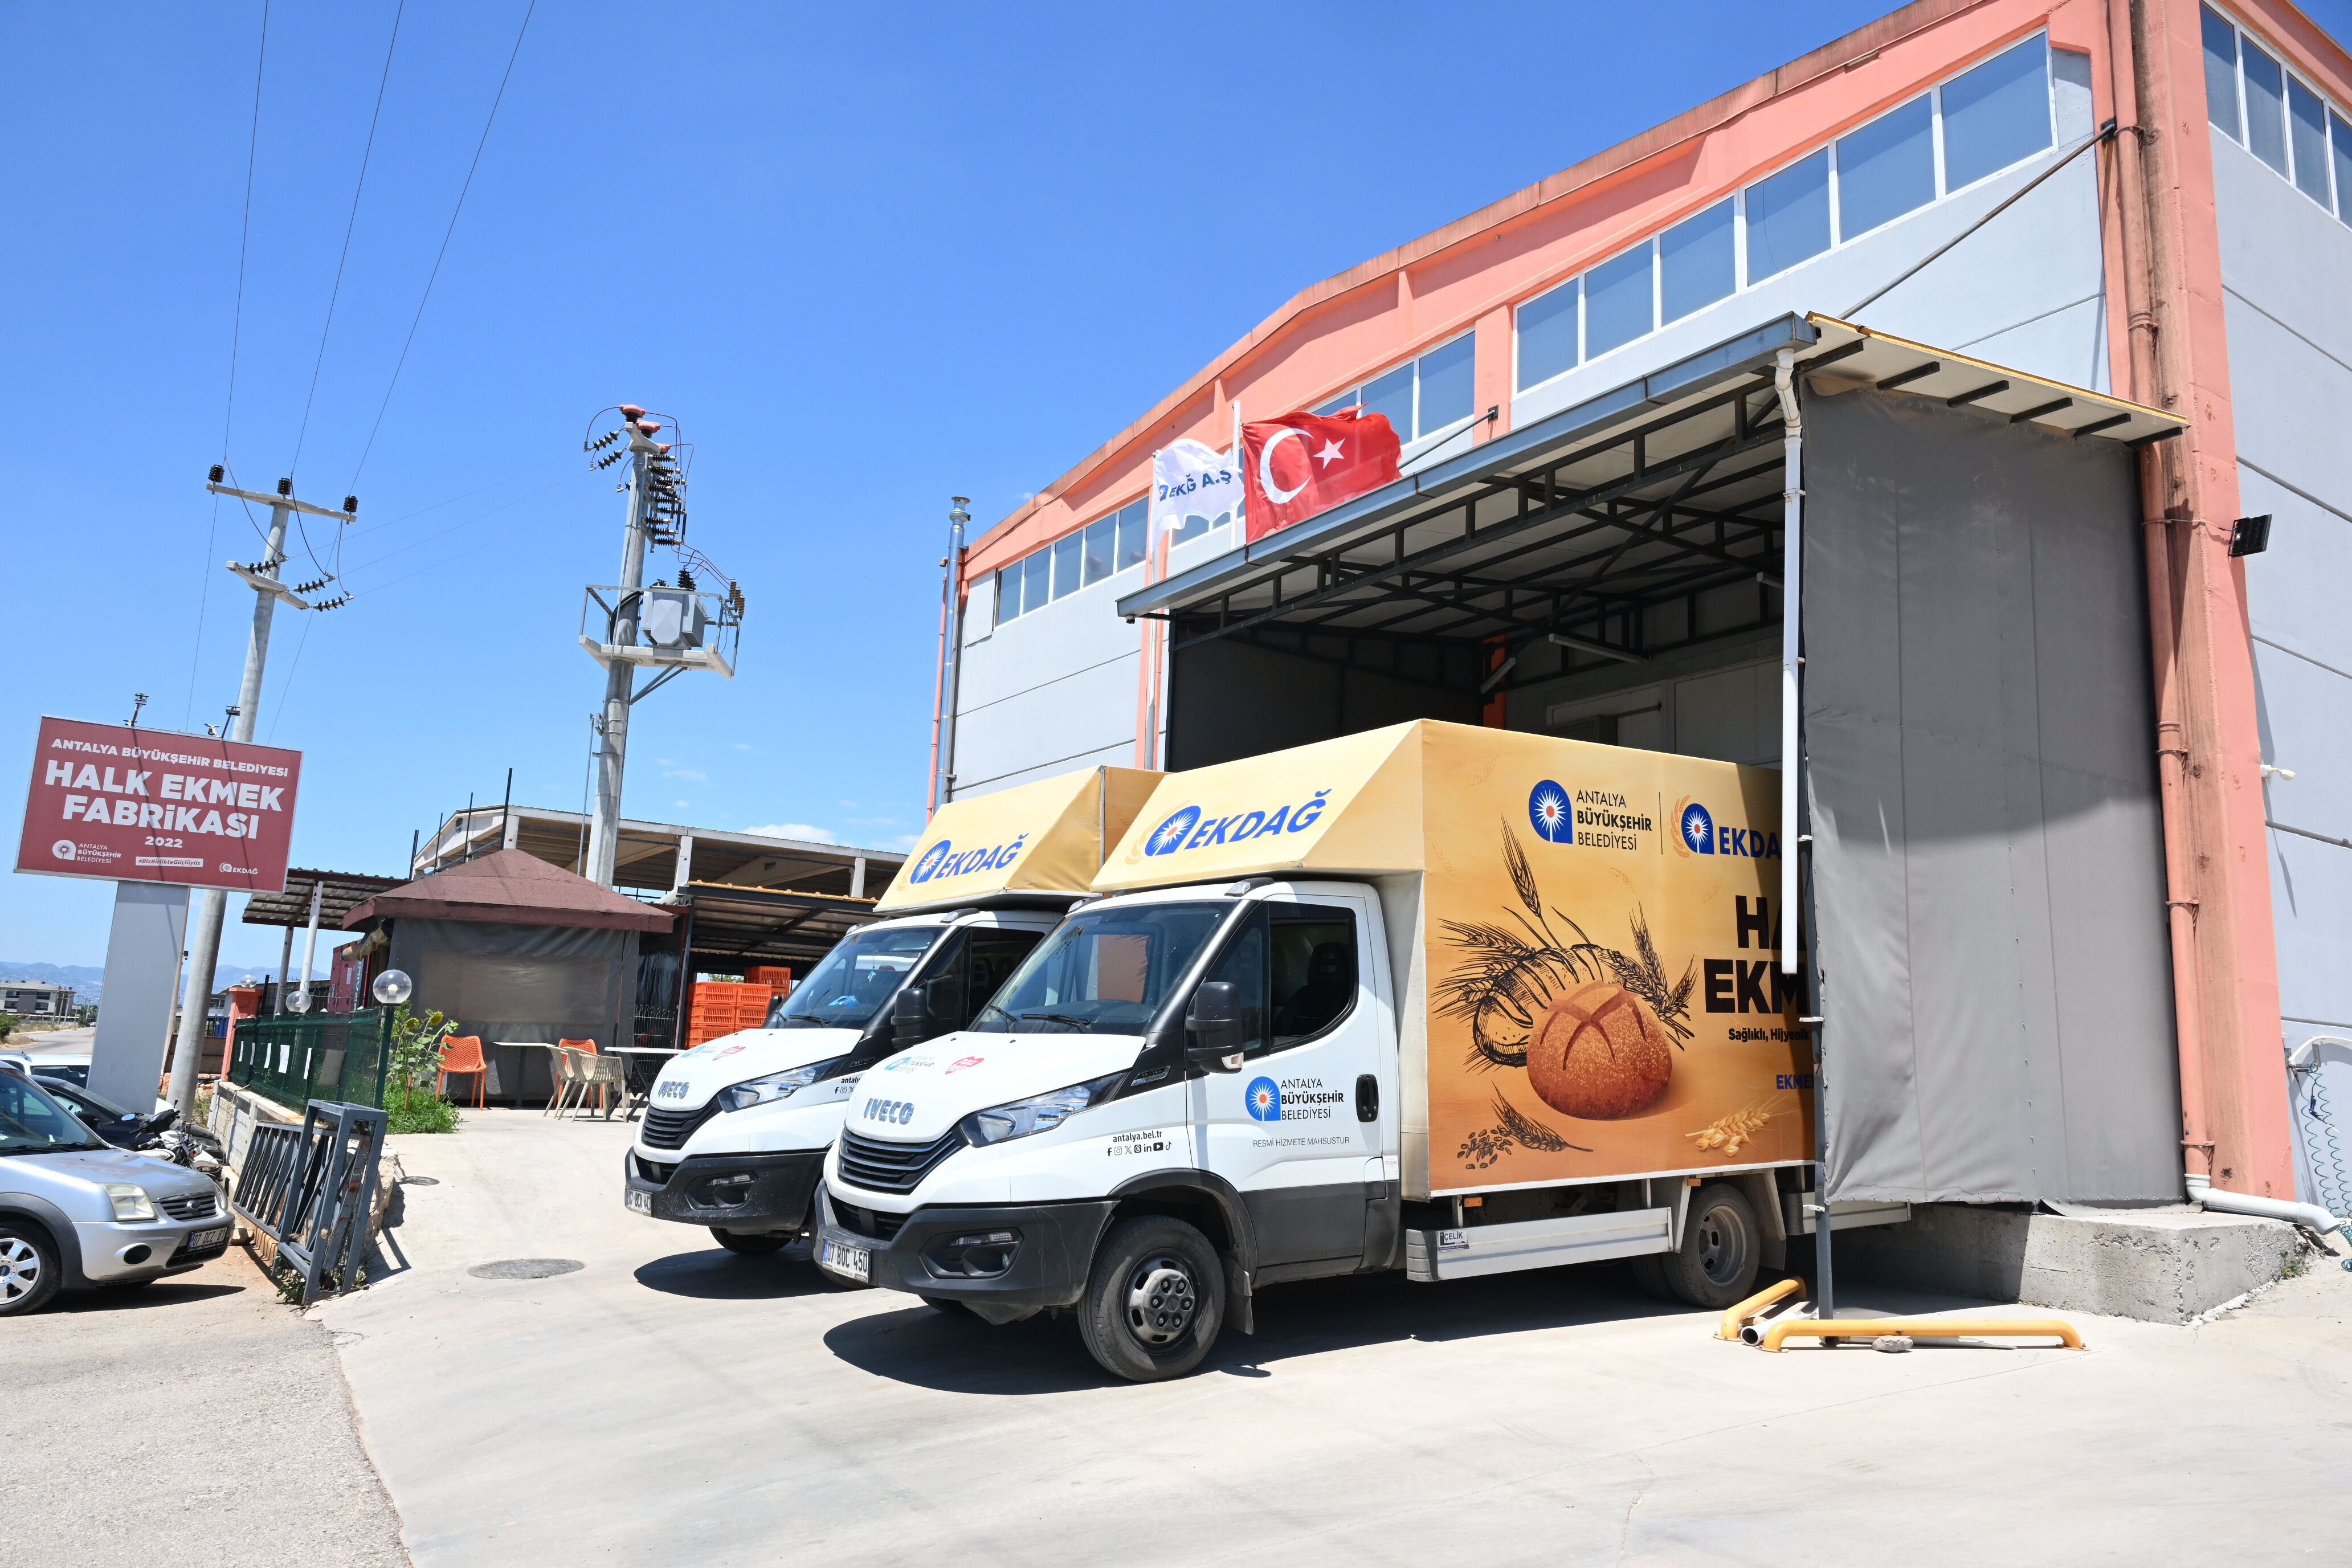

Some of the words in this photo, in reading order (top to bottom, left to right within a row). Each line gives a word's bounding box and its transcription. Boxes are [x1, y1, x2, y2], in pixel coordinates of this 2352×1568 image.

[51, 738, 118, 756] ANTALYA
[121, 746, 210, 767] BÜYÜKŞEHİR
[213, 758, 289, 777] BELEDİYESİ
[44, 760, 153, 796] HALK
[160, 773, 285, 811] EKMEK
[1576, 789, 1627, 808] ANTALYA
[62, 794, 259, 839] FABRİKASI
[1184, 788, 1333, 850] EKDAĞ
[1577, 807, 1653, 833] BÜYÜKŞEHİR
[145, 836, 183, 848] 2022
[1578, 831, 1637, 851] BELEDİYESİ
[1718, 826, 1782, 860] EKDA
[77, 849, 121, 858] BÜYÜKŞEHİR
[933, 832, 1030, 879] EKDAĞ
[1704, 958, 1808, 1015] EKM
[1728, 1027, 1769, 1042] Sağlıklı,
[1770, 1028, 1810, 1043] Hijyenik
[658, 1081, 690, 1100] IVECO
[1281, 1078, 1323, 1089] ANTALYA
[1281, 1089, 1345, 1105] BÜYÜKŞEHİR
[863, 1097, 914, 1125] IVECO
[1281, 1108, 1331, 1121] BELEDİYESİ
[1113, 1129, 1162, 1143] antalya.bel.tr
[1253, 1138, 1274, 1148] RESMİ
[1276, 1137, 1306, 1147] HİZMETE
[1307, 1136, 1350, 1145] MAHSUSTUR
[193, 1233, 202, 1246] 07
[1444, 1231, 1463, 1242] ÇELİK
[828, 1243, 835, 1263] 07
[837, 1246, 850, 1268] BOC
[854, 1250, 867, 1273] 450
